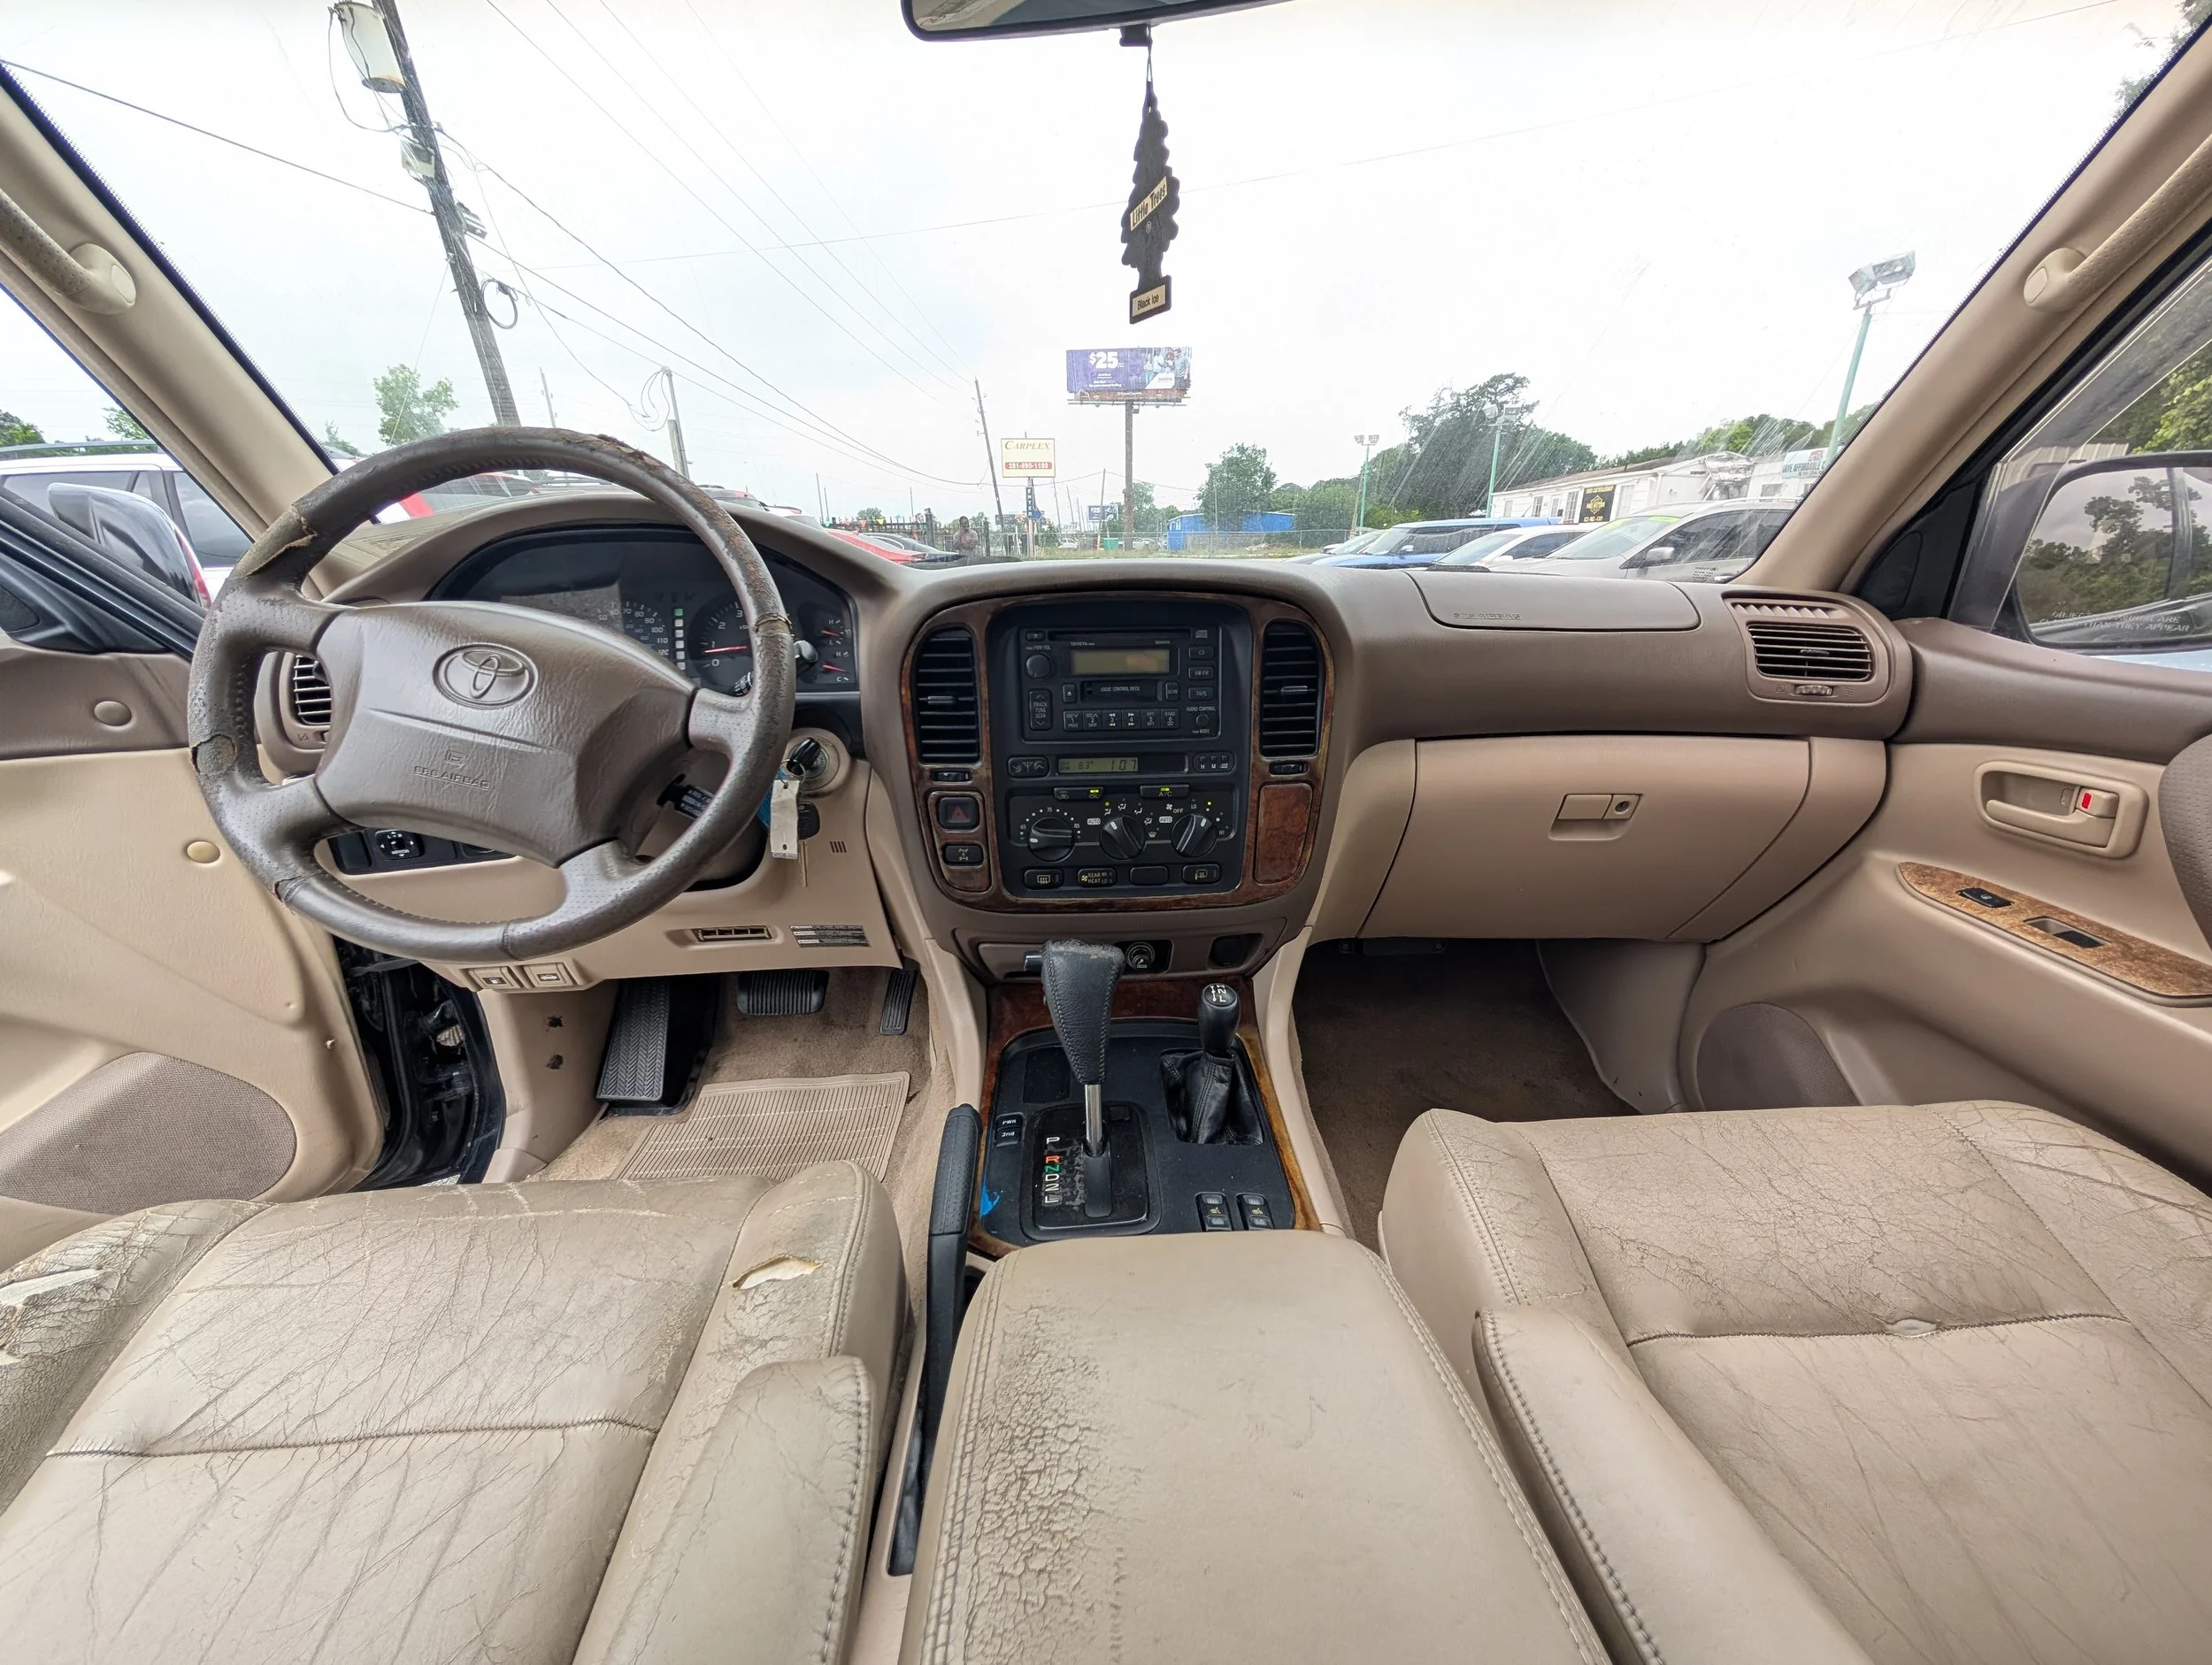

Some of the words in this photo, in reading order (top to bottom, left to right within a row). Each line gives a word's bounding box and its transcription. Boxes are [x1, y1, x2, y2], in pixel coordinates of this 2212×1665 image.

[1132, 201, 1148, 227] Little
[1150, 181, 1167, 209] Trees
[1137, 295, 1151, 311] Black
[1151, 293, 1160, 306] Ice
[1089, 351, 1119, 369] $25
[1004, 441, 1050, 450] CARPLEX
[414, 766, 439, 778] SRS
[441, 772, 490, 789] AIRBAG
[1046, 1136, 1061, 1145] P
[1045, 1173, 1060, 1182] D
[1045, 1183, 1060, 1192] 2
